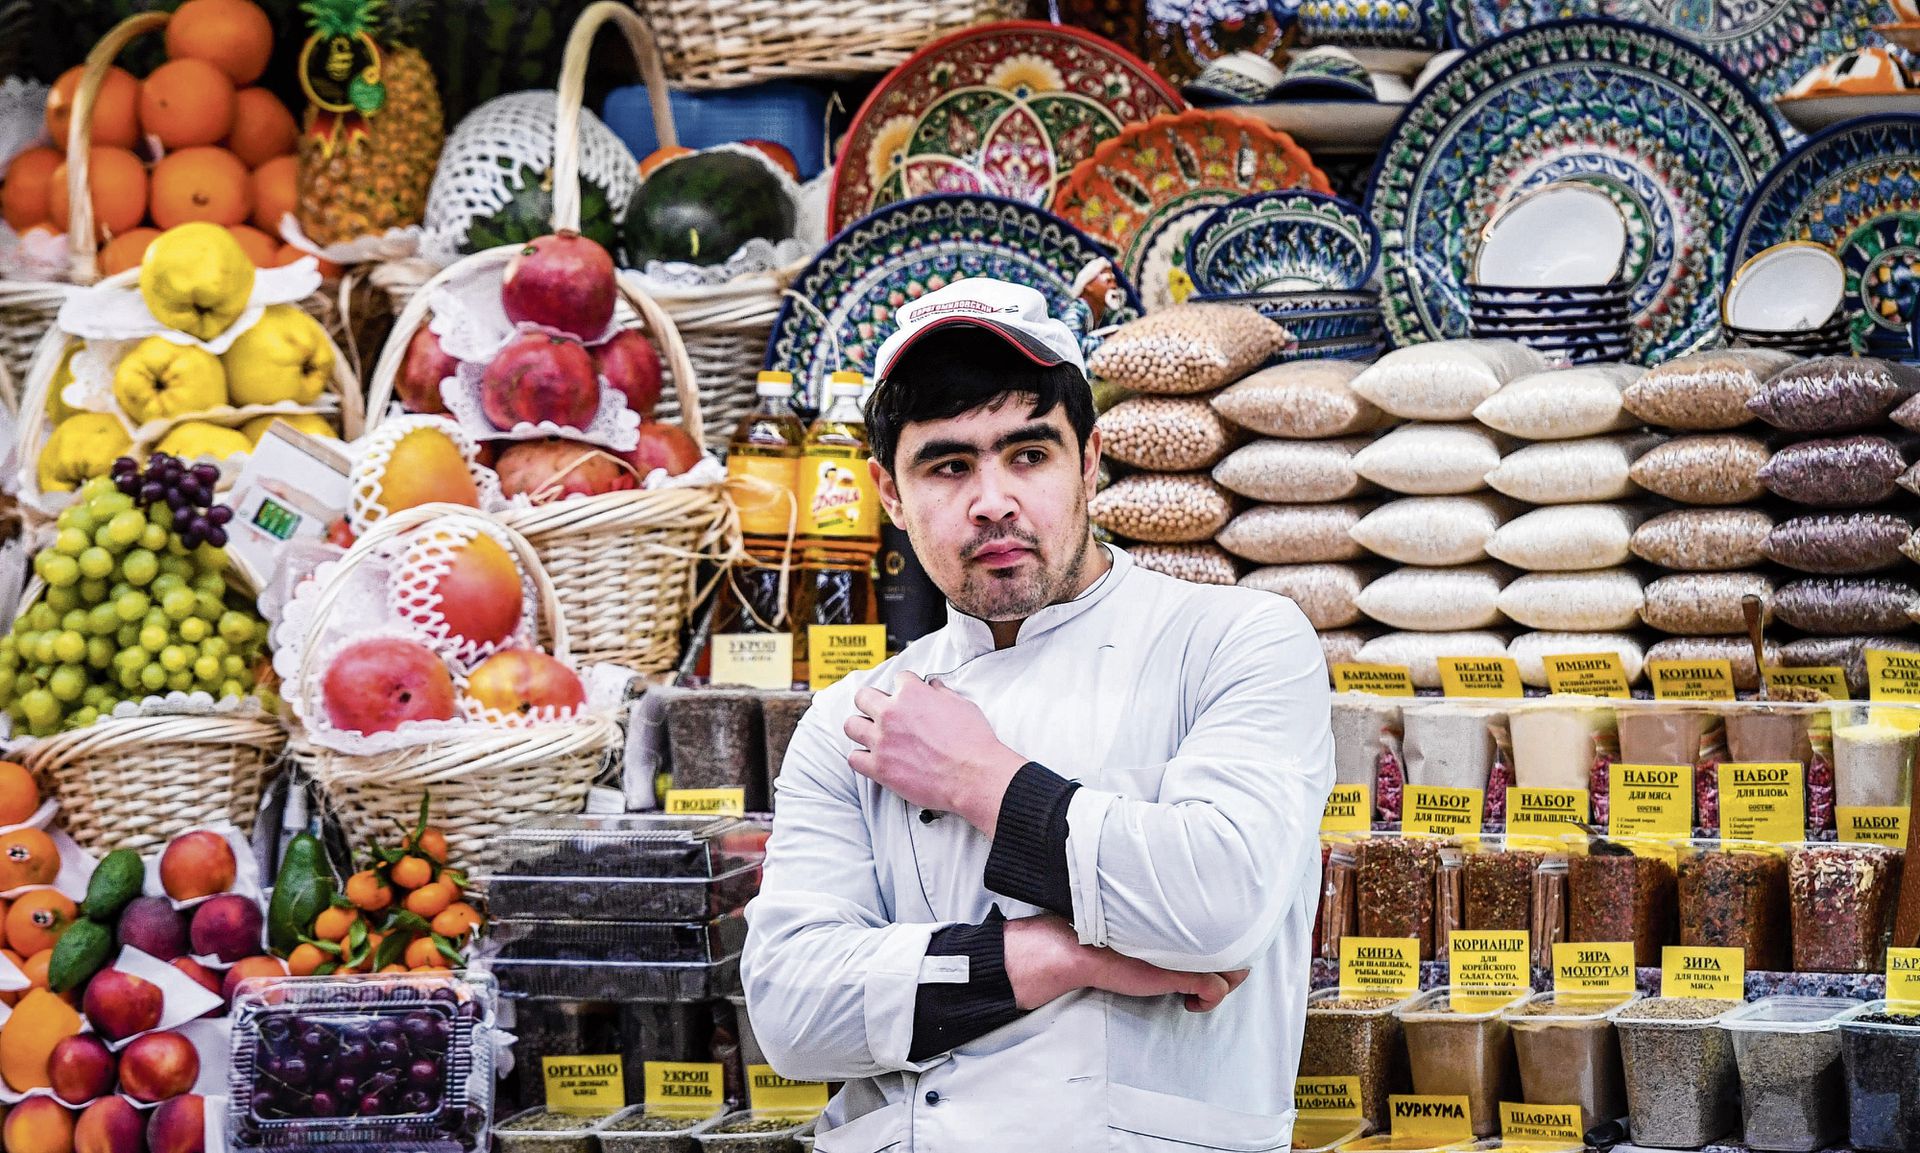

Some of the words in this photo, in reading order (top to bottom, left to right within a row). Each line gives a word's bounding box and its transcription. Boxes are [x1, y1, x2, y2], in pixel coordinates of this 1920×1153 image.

[829, 636, 866, 647] ТМИН
[1454, 662, 1503, 672] БЕЛЫЙ
[1556, 660, 1611, 672] ИМБИРЬ
[1343, 671, 1405, 681] КАРДАМОН
[1459, 673, 1504, 682] ПЕРЕЦ
[1659, 668, 1724, 680] КОРИЦА
[1772, 674, 1836, 685] МУСКАТ
[1623, 770, 1678, 783] НАБОР
[1734, 769, 1789, 782] НАБОР
[1628, 791, 1646, 801] ДЛЯ
[1648, 791, 1672, 801] МЯСА
[1736, 789, 1755, 799] ДЛЯ
[1757, 788, 1788, 797] ПЛОВА
[1417, 793, 1470, 807] НАБОР
[1521, 794, 1575, 807] НАБОР
[1414, 812, 1432, 822] ДЛЯ
[1435, 814, 1470, 824] ПЕРВЫХ
[1513, 813, 1530, 823] ДЛЯ
[1534, 814, 1583, 822] ШАШЛЫКА
[1853, 817, 1899, 828] НАБОР
[1430, 826, 1455, 835] БЛЮД
[1873, 832, 1899, 840] ХАРЧО
[1453, 940, 1524, 952] КОРИАНДР
[1357, 948, 1403, 959] КИНЗА
[1578, 952, 1610, 963] ЗИРА
[1683, 957, 1721, 969] ЗИРА
[1893, 957, 1920, 970] БАР
[1561, 966, 1629, 978] МОЛОТАЯ
[548, 1064, 618, 1077] ОРЕГАНО
[663, 1070, 708, 1082] УКРОП
[661, 1085, 712, 1096] ЗЕЛЕНЬ
[1296, 1084, 1348, 1095] ЛИСТЬЯ
[1395, 1101, 1465, 1119] КУРКУМА
[1511, 1111, 1572, 1125] ШАФРАН
